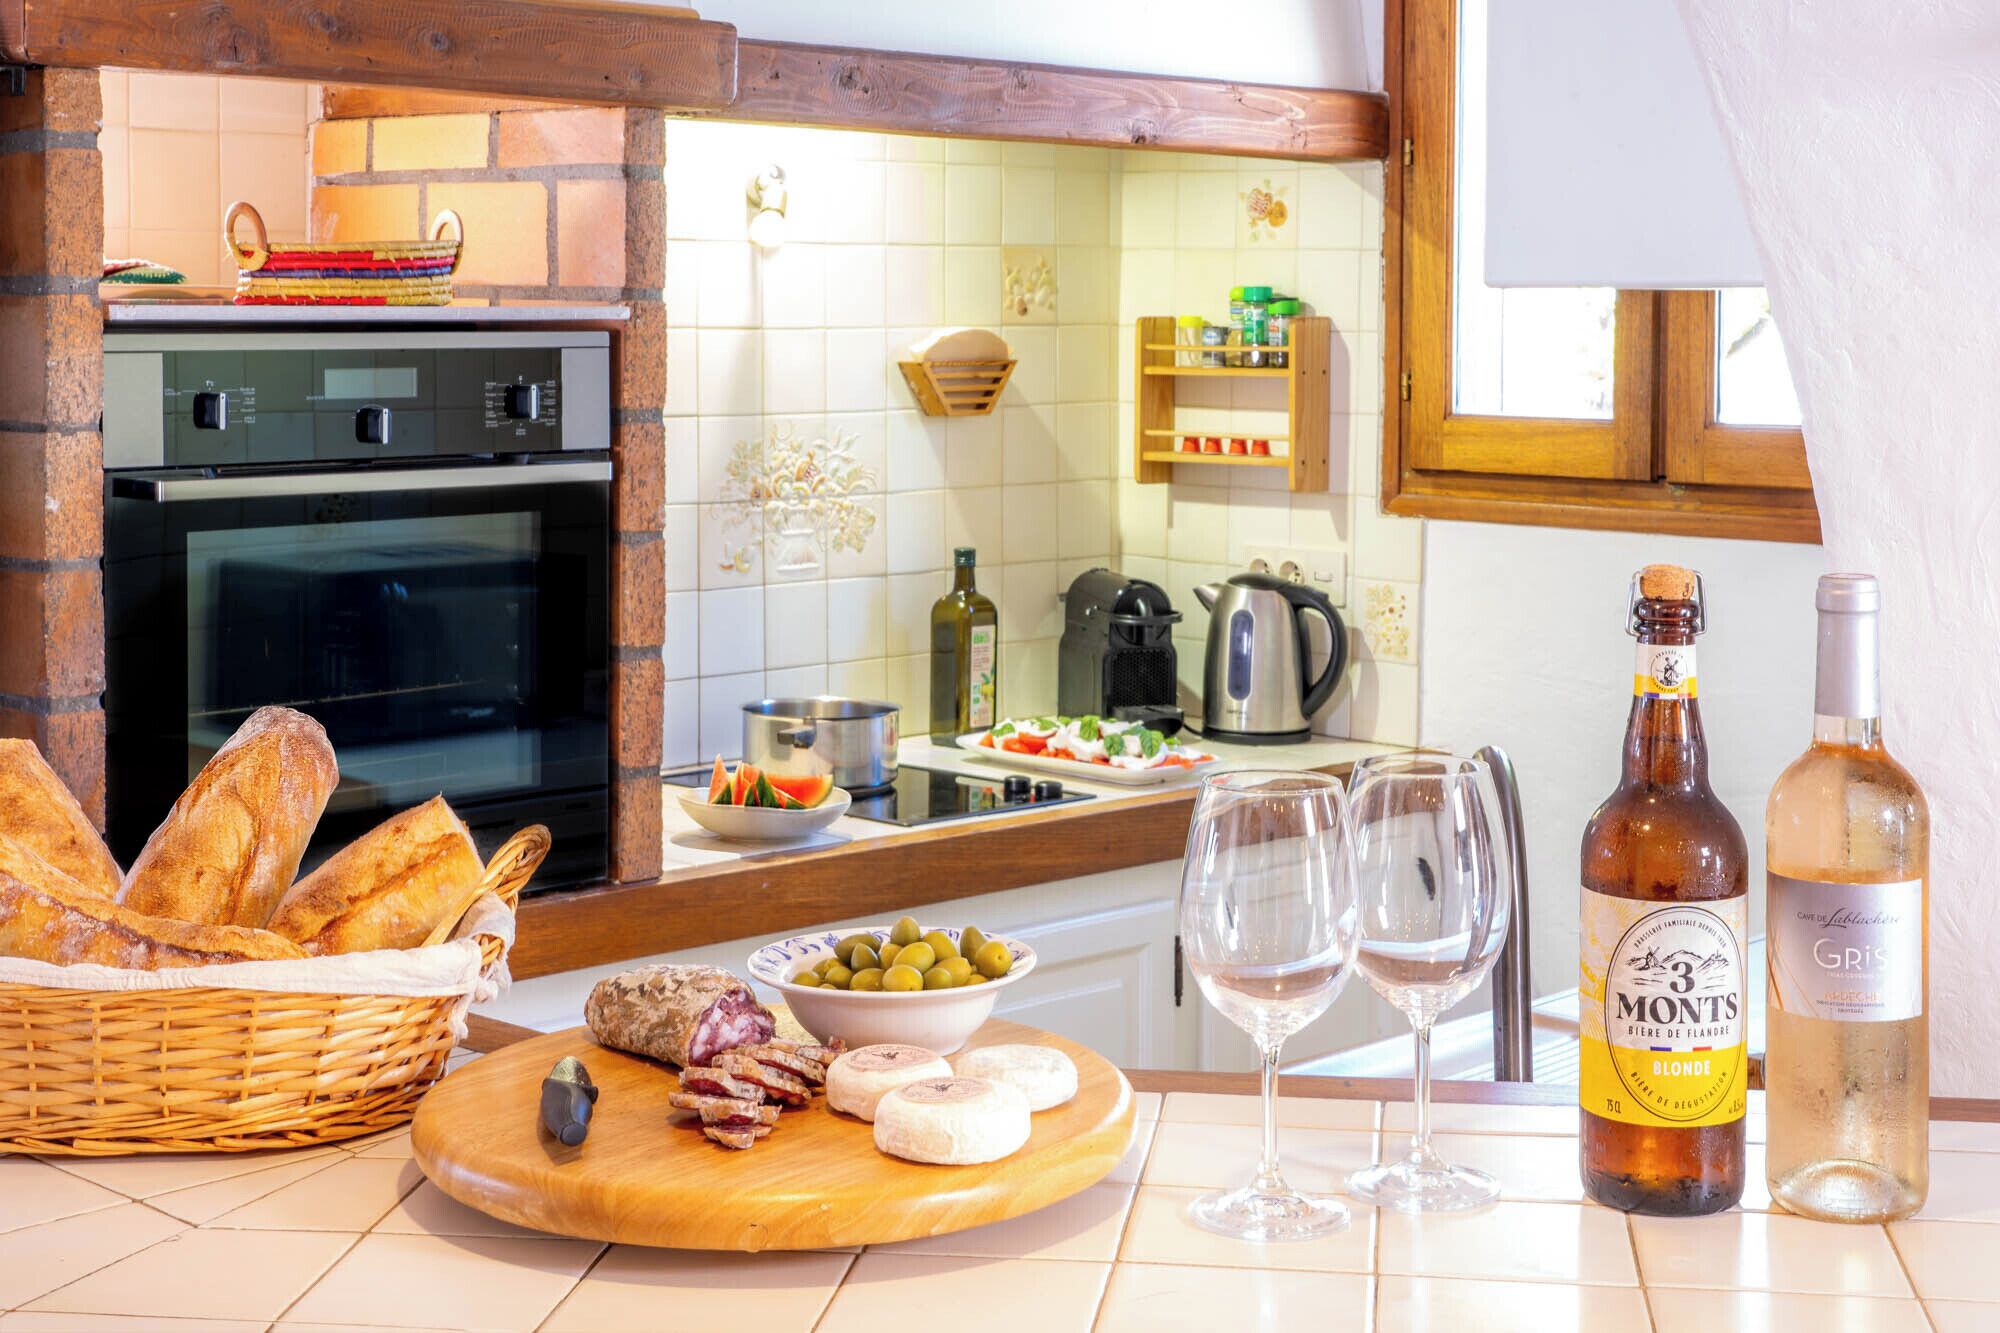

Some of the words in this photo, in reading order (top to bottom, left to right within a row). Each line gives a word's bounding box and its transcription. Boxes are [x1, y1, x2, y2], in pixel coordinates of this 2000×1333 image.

[1664, 919, 1696, 928] FAMILIALE
[1797, 912, 1816, 921] CAVE
[1817, 915, 1827, 923] DE
[1669, 961, 1695, 994] 3
[1616, 992, 1738, 1025] MONTS
[1668, 1029, 1680, 1038] DE
[1688, 1025, 1729, 1038] FLANDRE
[1653, 1060, 1711, 1076] BLONDE
[1657, 1095, 1669, 1107] DE
